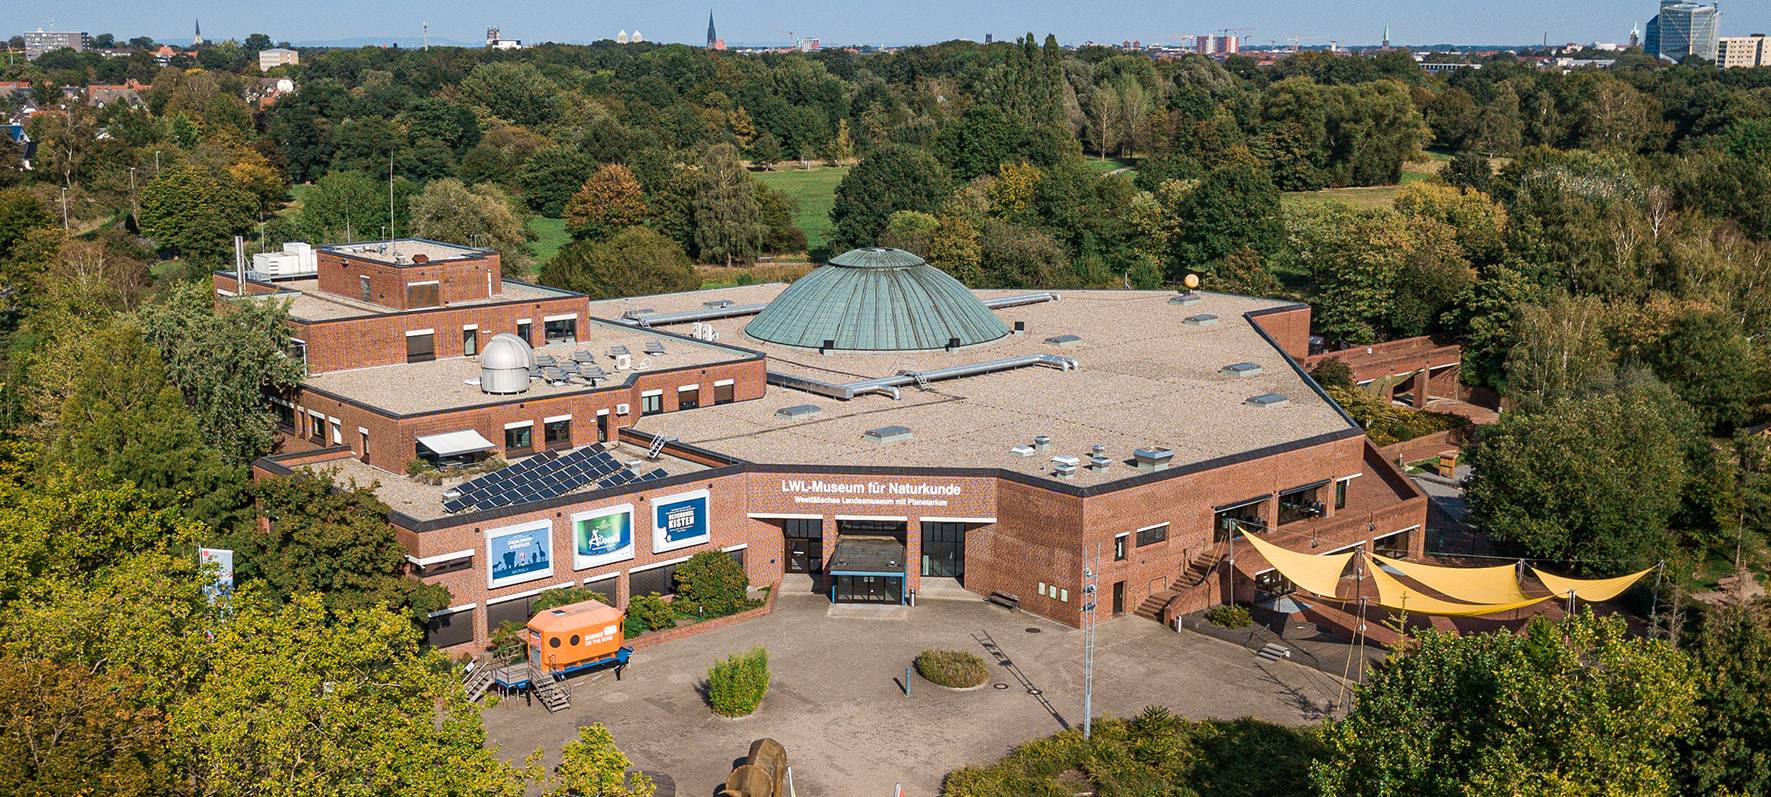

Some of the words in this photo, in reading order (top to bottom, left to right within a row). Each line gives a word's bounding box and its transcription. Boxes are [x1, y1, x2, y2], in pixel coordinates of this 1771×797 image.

[781, 480, 865, 493] LWL-Museum
[867, 482, 886, 494] für
[888, 482, 961, 496] Naturkunde
[795, 496, 841, 504] Westfälisches
[841, 497, 894, 505] Landesmuseum
[907, 498, 948, 506] Planetarium
[668, 516, 695, 528] KISTEN
